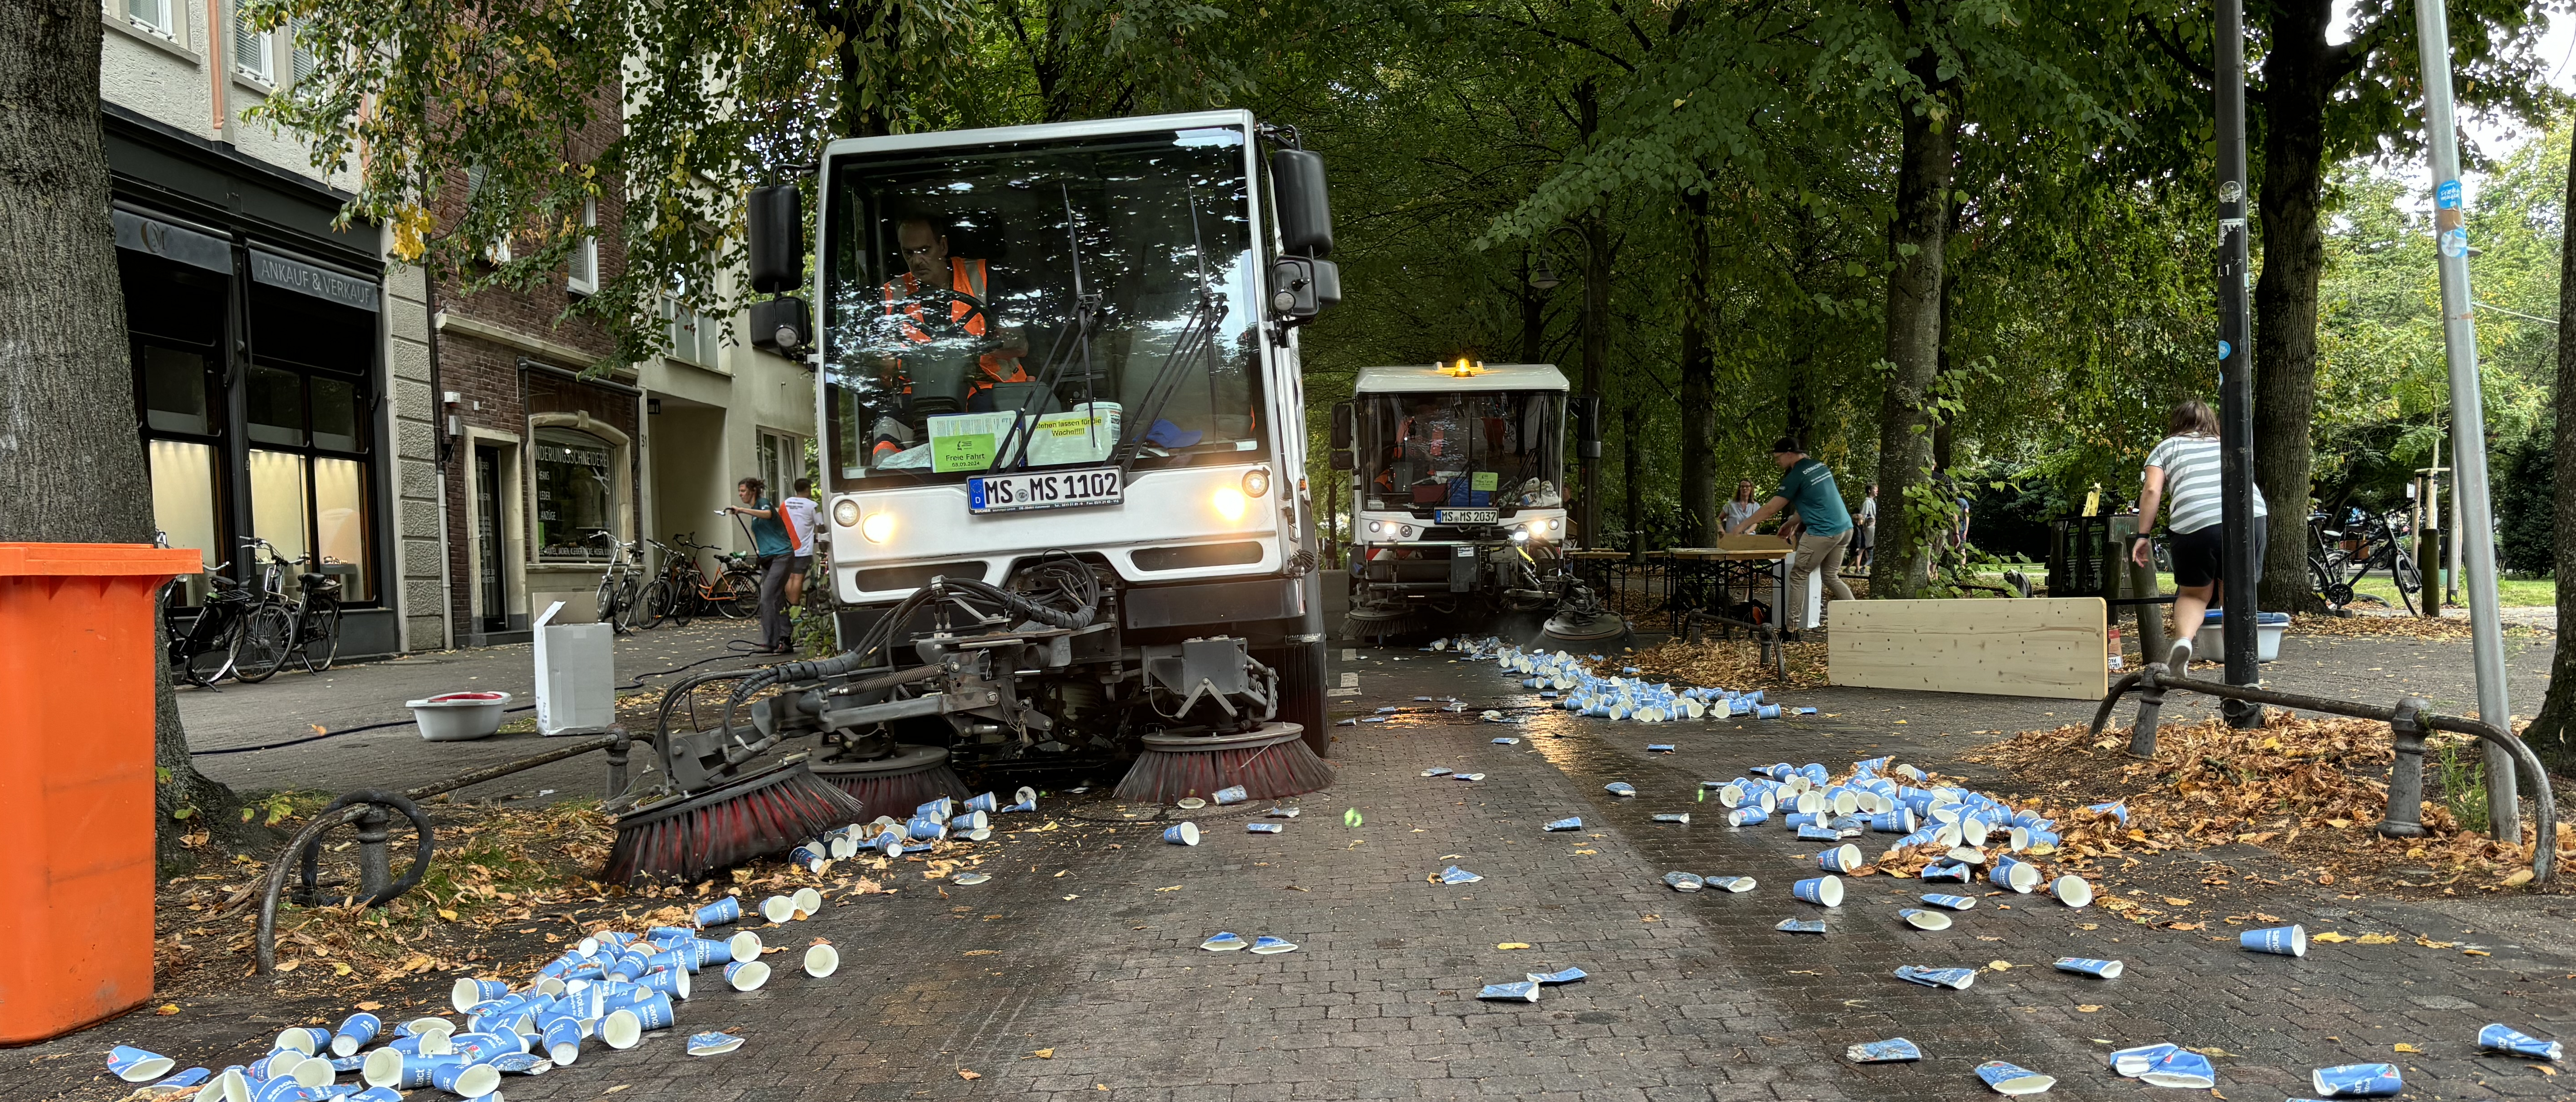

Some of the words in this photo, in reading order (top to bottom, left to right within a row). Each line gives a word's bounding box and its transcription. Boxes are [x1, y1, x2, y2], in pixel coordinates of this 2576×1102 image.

[262, 260, 308, 286] ANKAUF
[312, 273, 321, 291] &
[323, 277, 369, 303] VERKAUF
[641, 434, 647, 449] 31
[985, 480, 1013, 504] MS
[1029, 477, 1058, 502] MS
[1063, 473, 1118, 499] 1102
[1442, 511, 1453, 521] MS
[1460, 511, 1471, 521] MS
[1474, 511, 1496, 521] 2037
